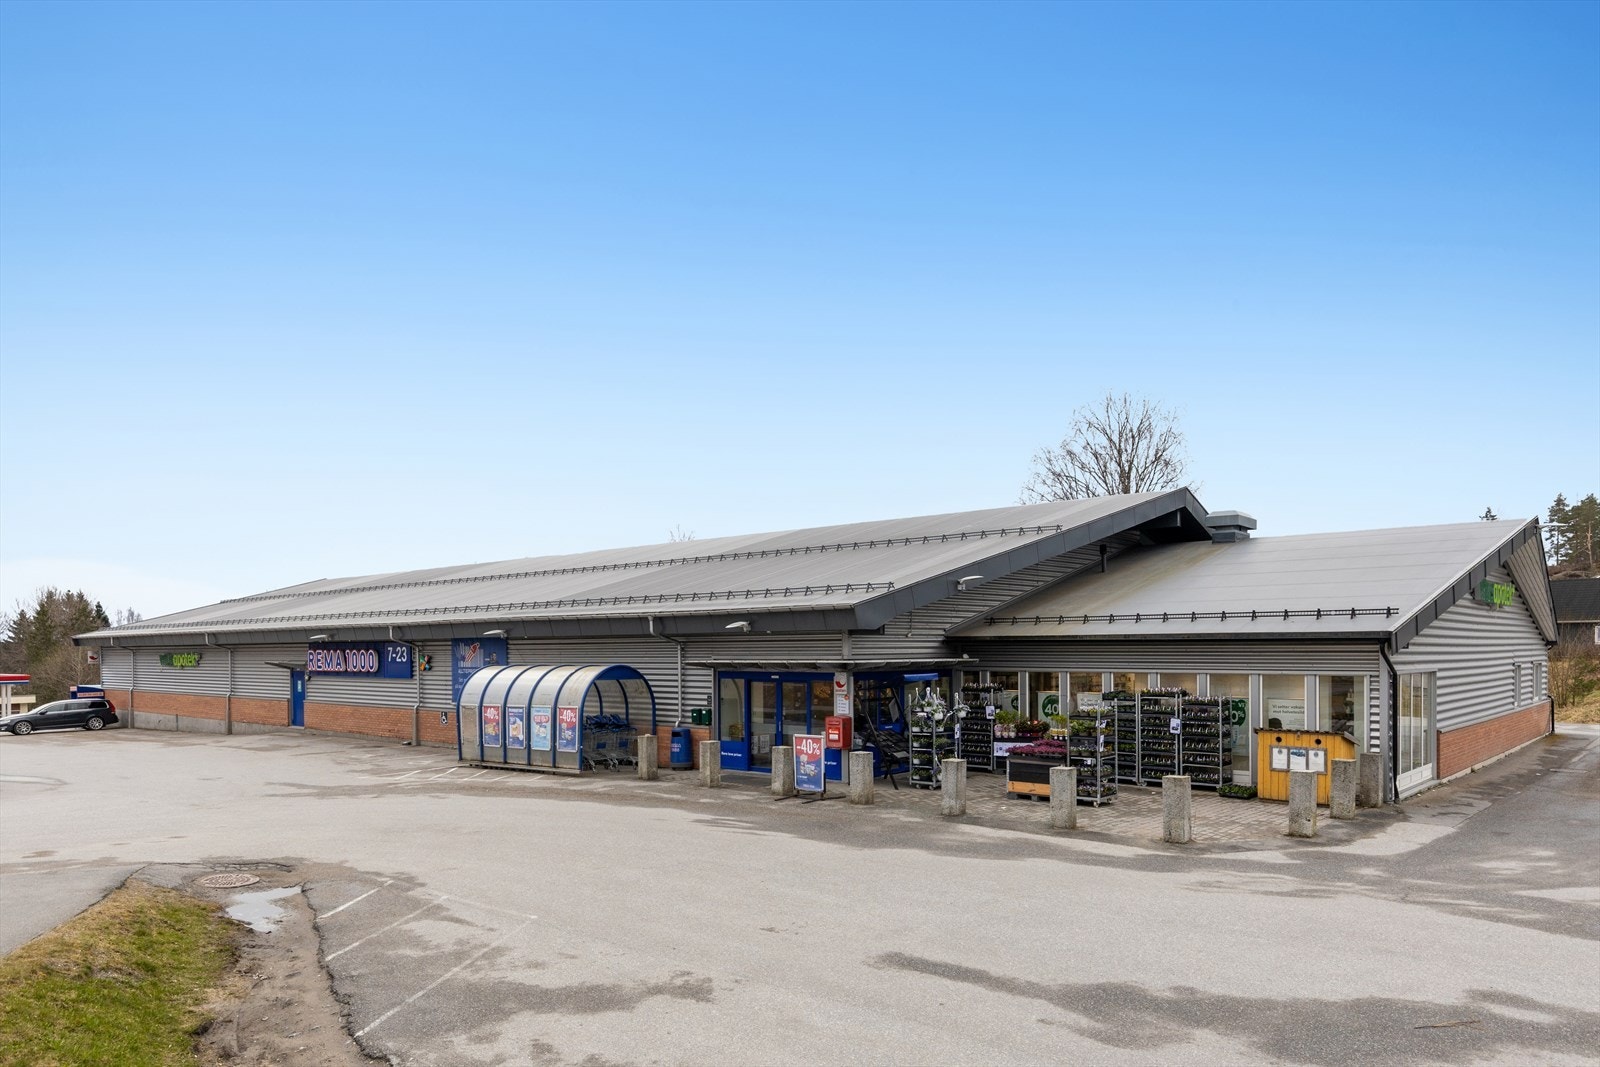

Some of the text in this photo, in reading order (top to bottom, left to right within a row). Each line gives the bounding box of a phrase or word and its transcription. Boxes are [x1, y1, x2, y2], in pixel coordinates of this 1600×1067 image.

[308, 650, 377, 672] REMA 1000
[387, 647, 408, 662] 7-23
[484, 707, 499, 720] -40%
[559, 709, 576, 723] -40%
[796, 739, 820, 755] -40%
